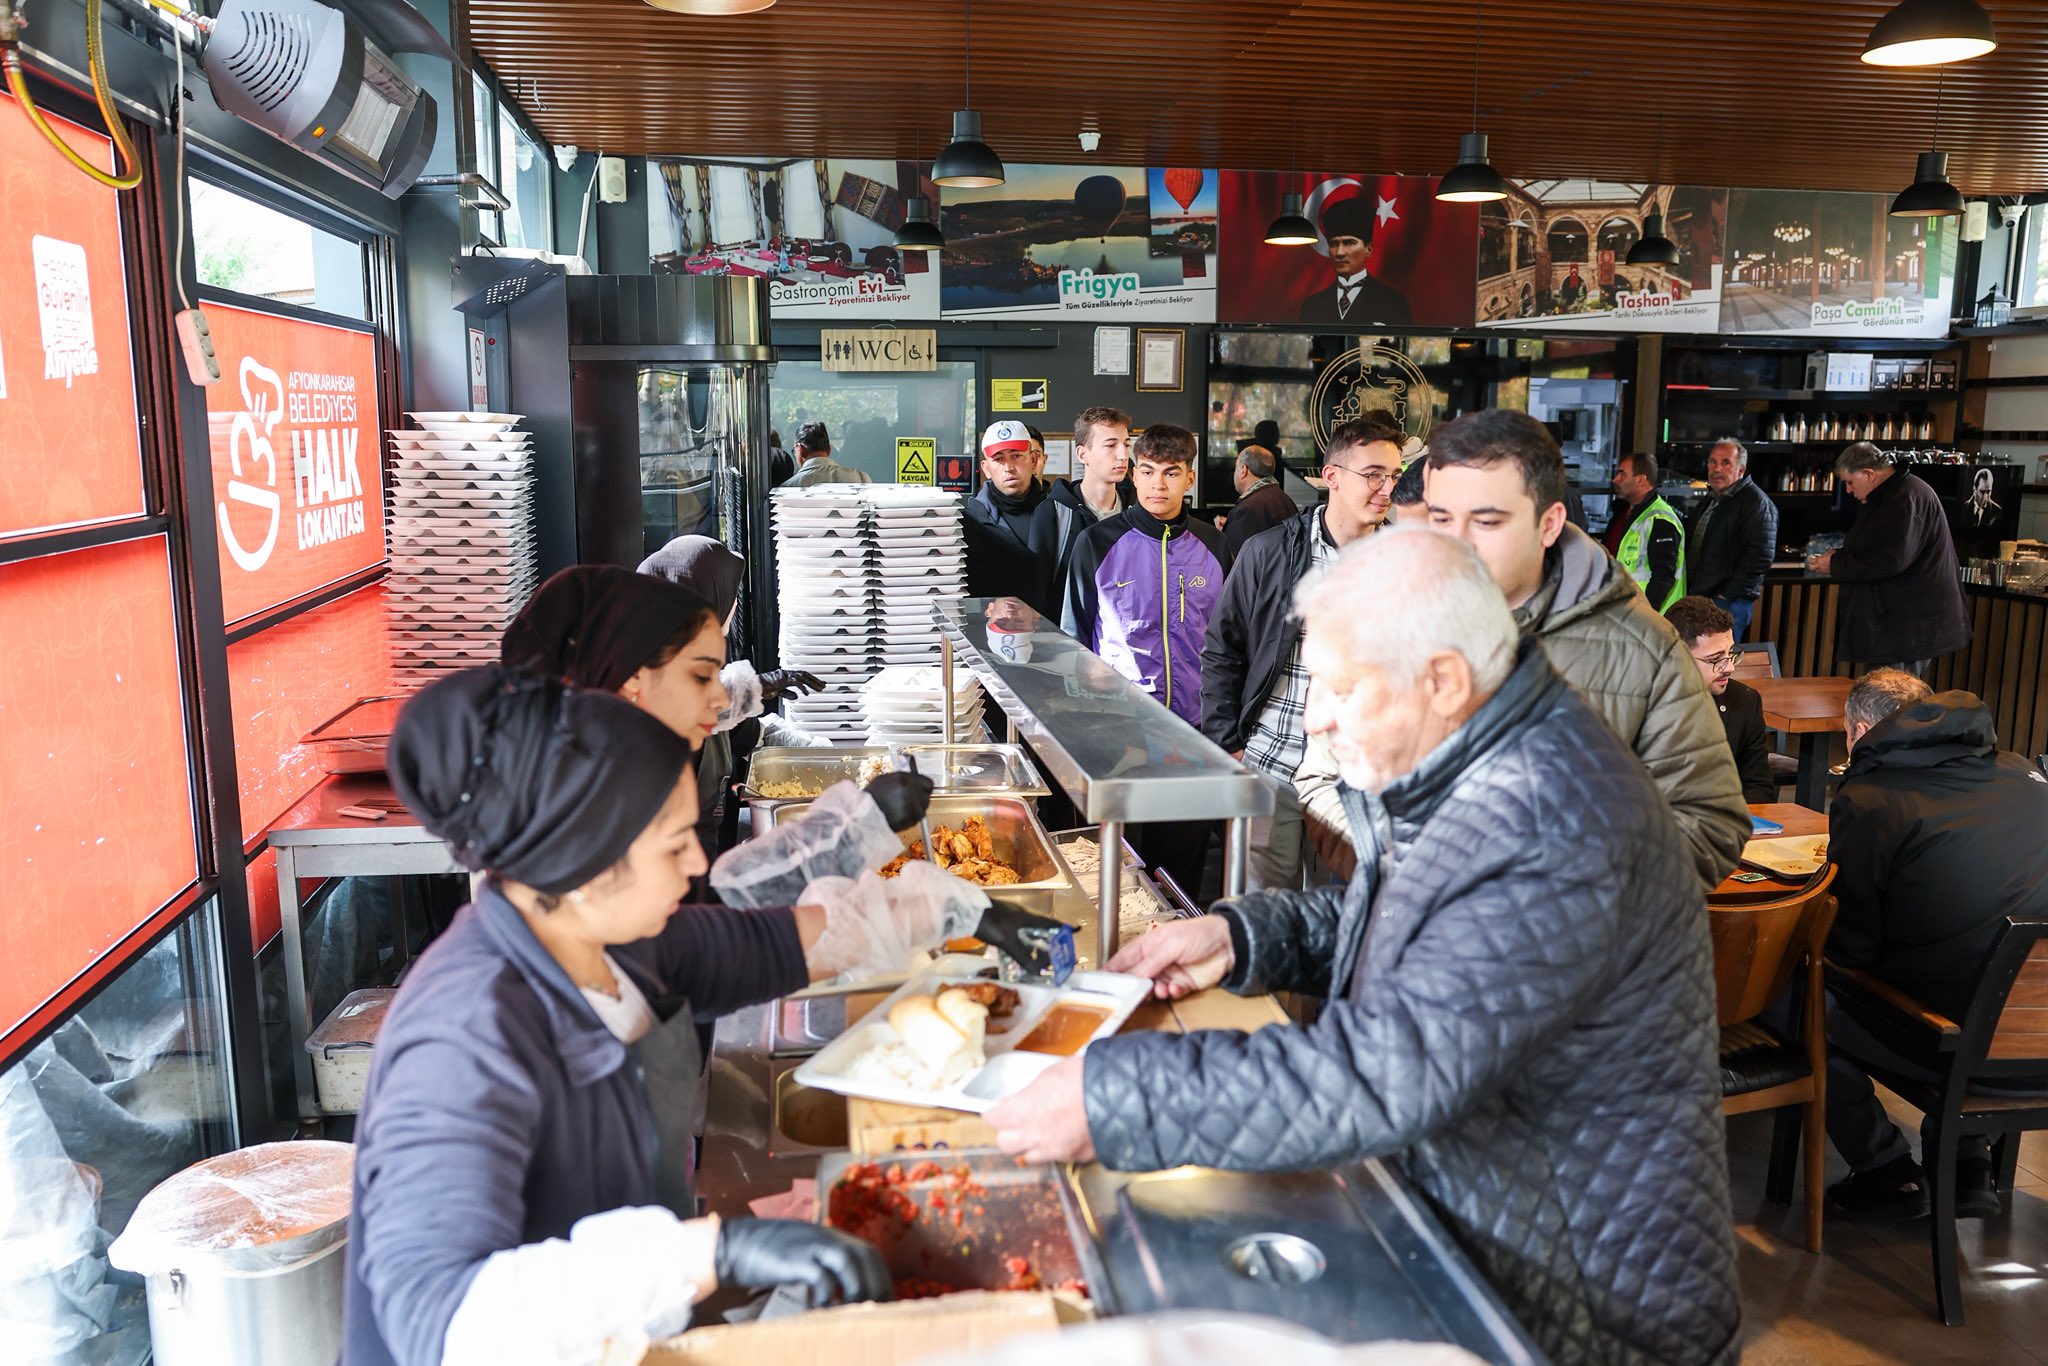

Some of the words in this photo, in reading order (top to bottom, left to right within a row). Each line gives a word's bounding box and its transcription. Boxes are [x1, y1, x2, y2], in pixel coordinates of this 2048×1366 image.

[769, 282, 854, 300] Gastronomi
[858, 277, 884, 295] Evi
[1062, 271, 1137, 299] Frigya
[829, 295, 875, 307] Ziyaretinizi
[876, 293, 911, 304] Bekliyor
[1065, 302, 1080, 310] Tüm
[1081, 299, 1132, 309] Güzellikleriyle
[1134, 296, 1168, 307] Ziyaretinizi
[1169, 295, 1193, 304] Bekliyor
[1814, 305, 1842, 321] Paşa
[1845, 301, 1901, 317] Camii'ni
[1863, 317, 1904, 327] Gördünüz
[1906, 315, 1924, 325] mü?
[857, 340, 901, 361] WC
[292, 428, 363, 508] HALK
[297, 500, 365, 551] LOKANTASI
